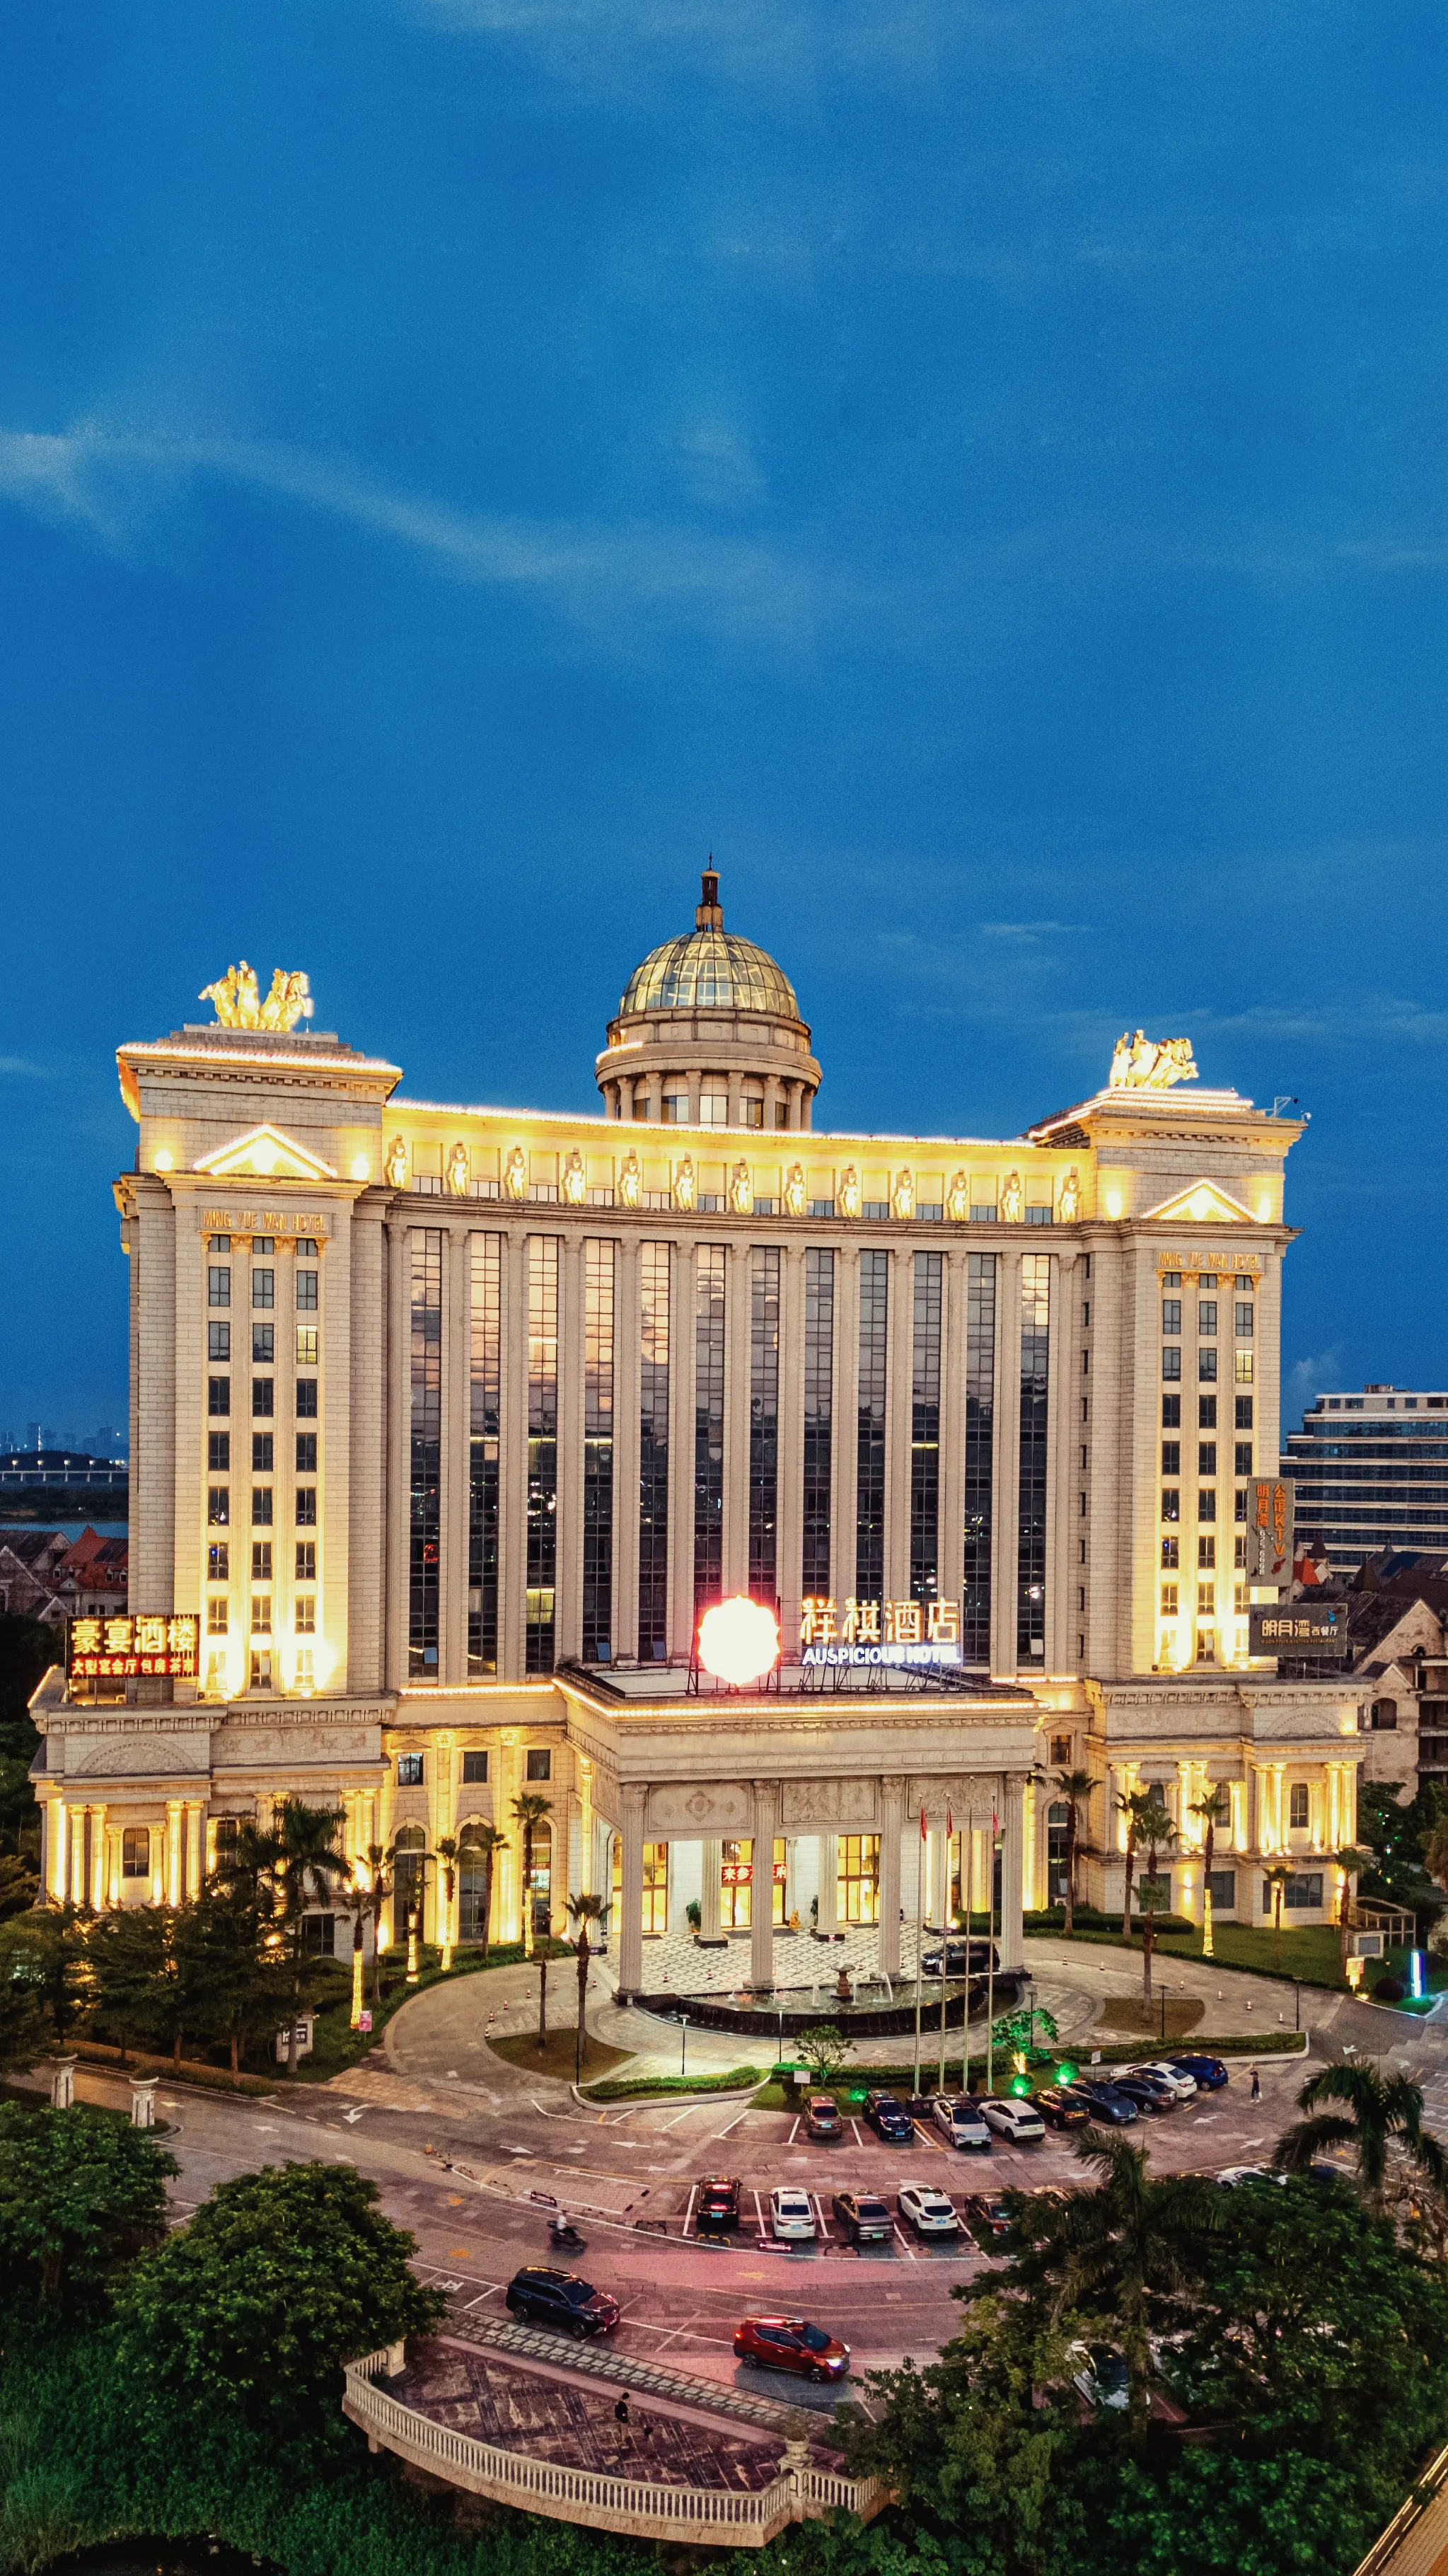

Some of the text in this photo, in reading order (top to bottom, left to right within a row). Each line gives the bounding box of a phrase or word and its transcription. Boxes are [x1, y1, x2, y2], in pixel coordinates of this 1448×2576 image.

[203, 1211, 325, 1232] MING YUE WAN HOTEL
[1158, 1252, 1259, 1270] MING YUE WAN HOTEL
[1256, 1484, 1270, 1527] 明月湾
[799, 1597, 959, 1645] 祥祺酒店
[1261, 1619, 1339, 1637] 明月湾 西餐厅
[71, 1616, 195, 1654] 豪宴酒楼
[802, 1645, 961, 1665] AUSPICIOUS HOTEL
[72, 1658, 195, 1675] 大型宴会厅 包房 茶市
